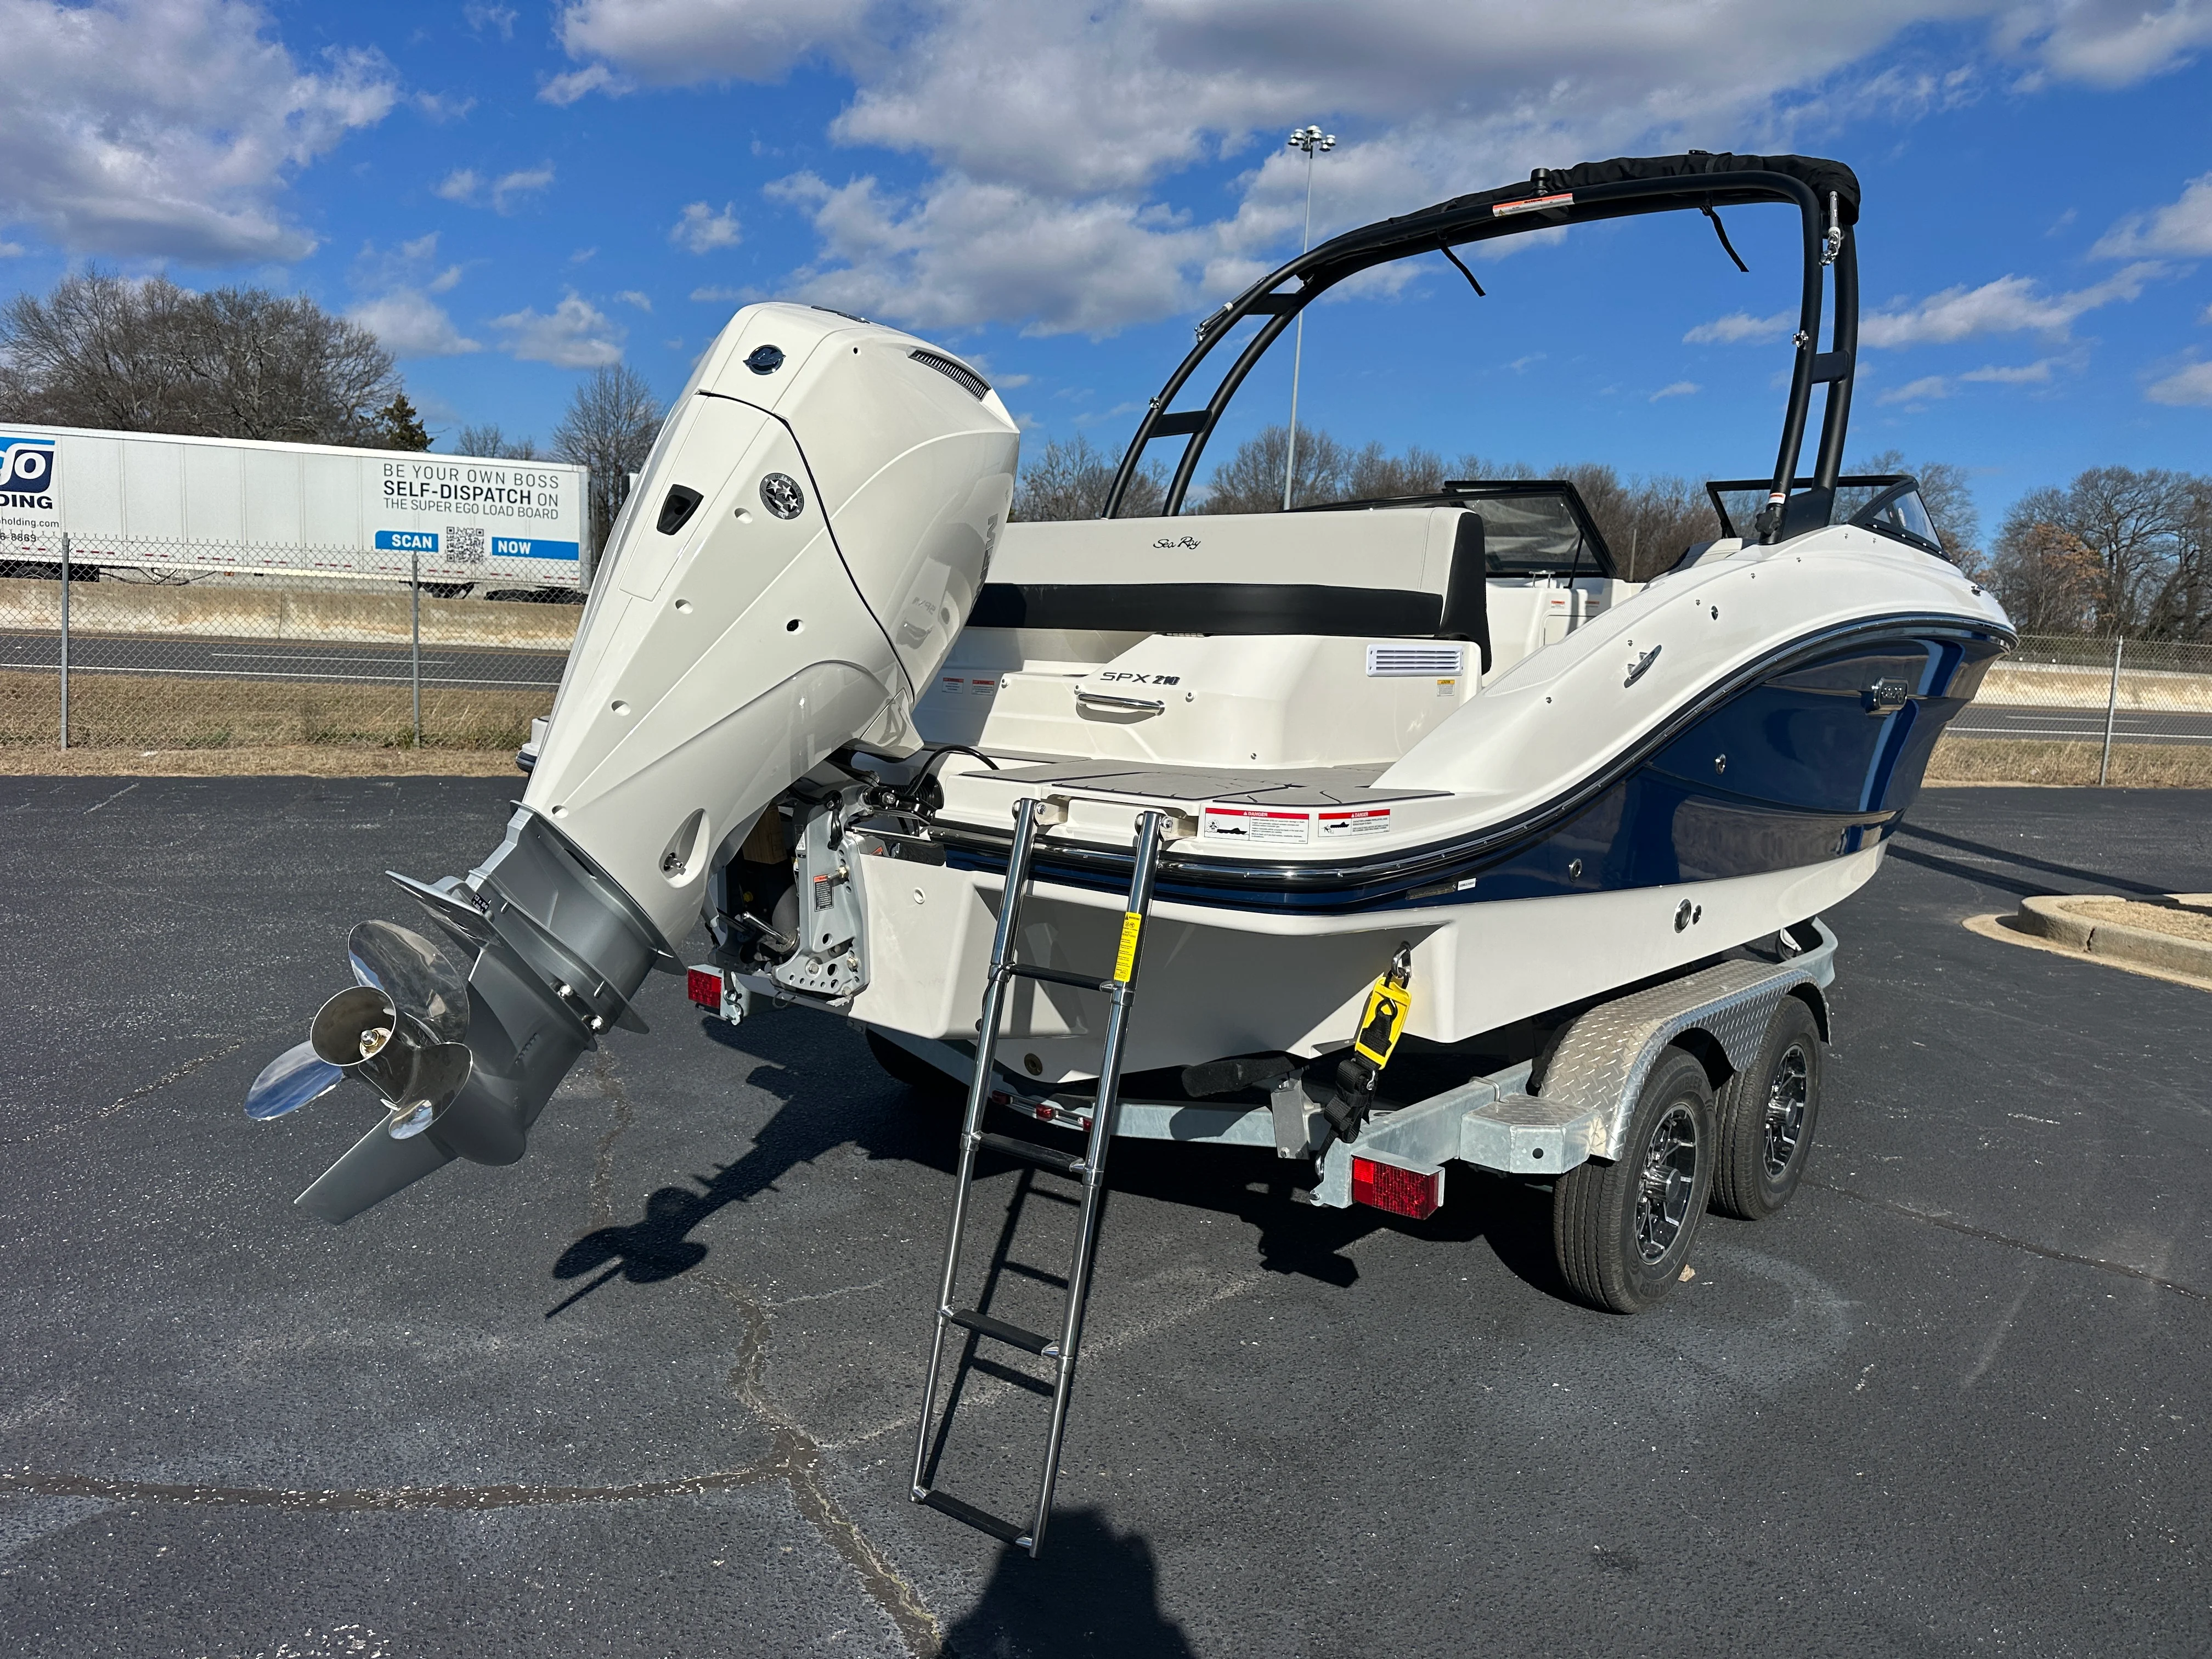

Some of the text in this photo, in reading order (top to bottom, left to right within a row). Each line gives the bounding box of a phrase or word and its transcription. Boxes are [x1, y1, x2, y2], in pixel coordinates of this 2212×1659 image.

[384, 464, 558, 489] BE YOUR OWN BOSS
[383, 480, 558, 507] SELF-DISPATCH ON
[384, 498, 558, 520] THE SUPER EGO LOAD BOARD
[0, 517, 59, 528] holding.com
[391, 533, 432, 549] SCAN
[498, 541, 532, 555] NOW
[1153, 536, 1201, 550] Sea Ray
[1100, 672, 1181, 685] SPX 210
